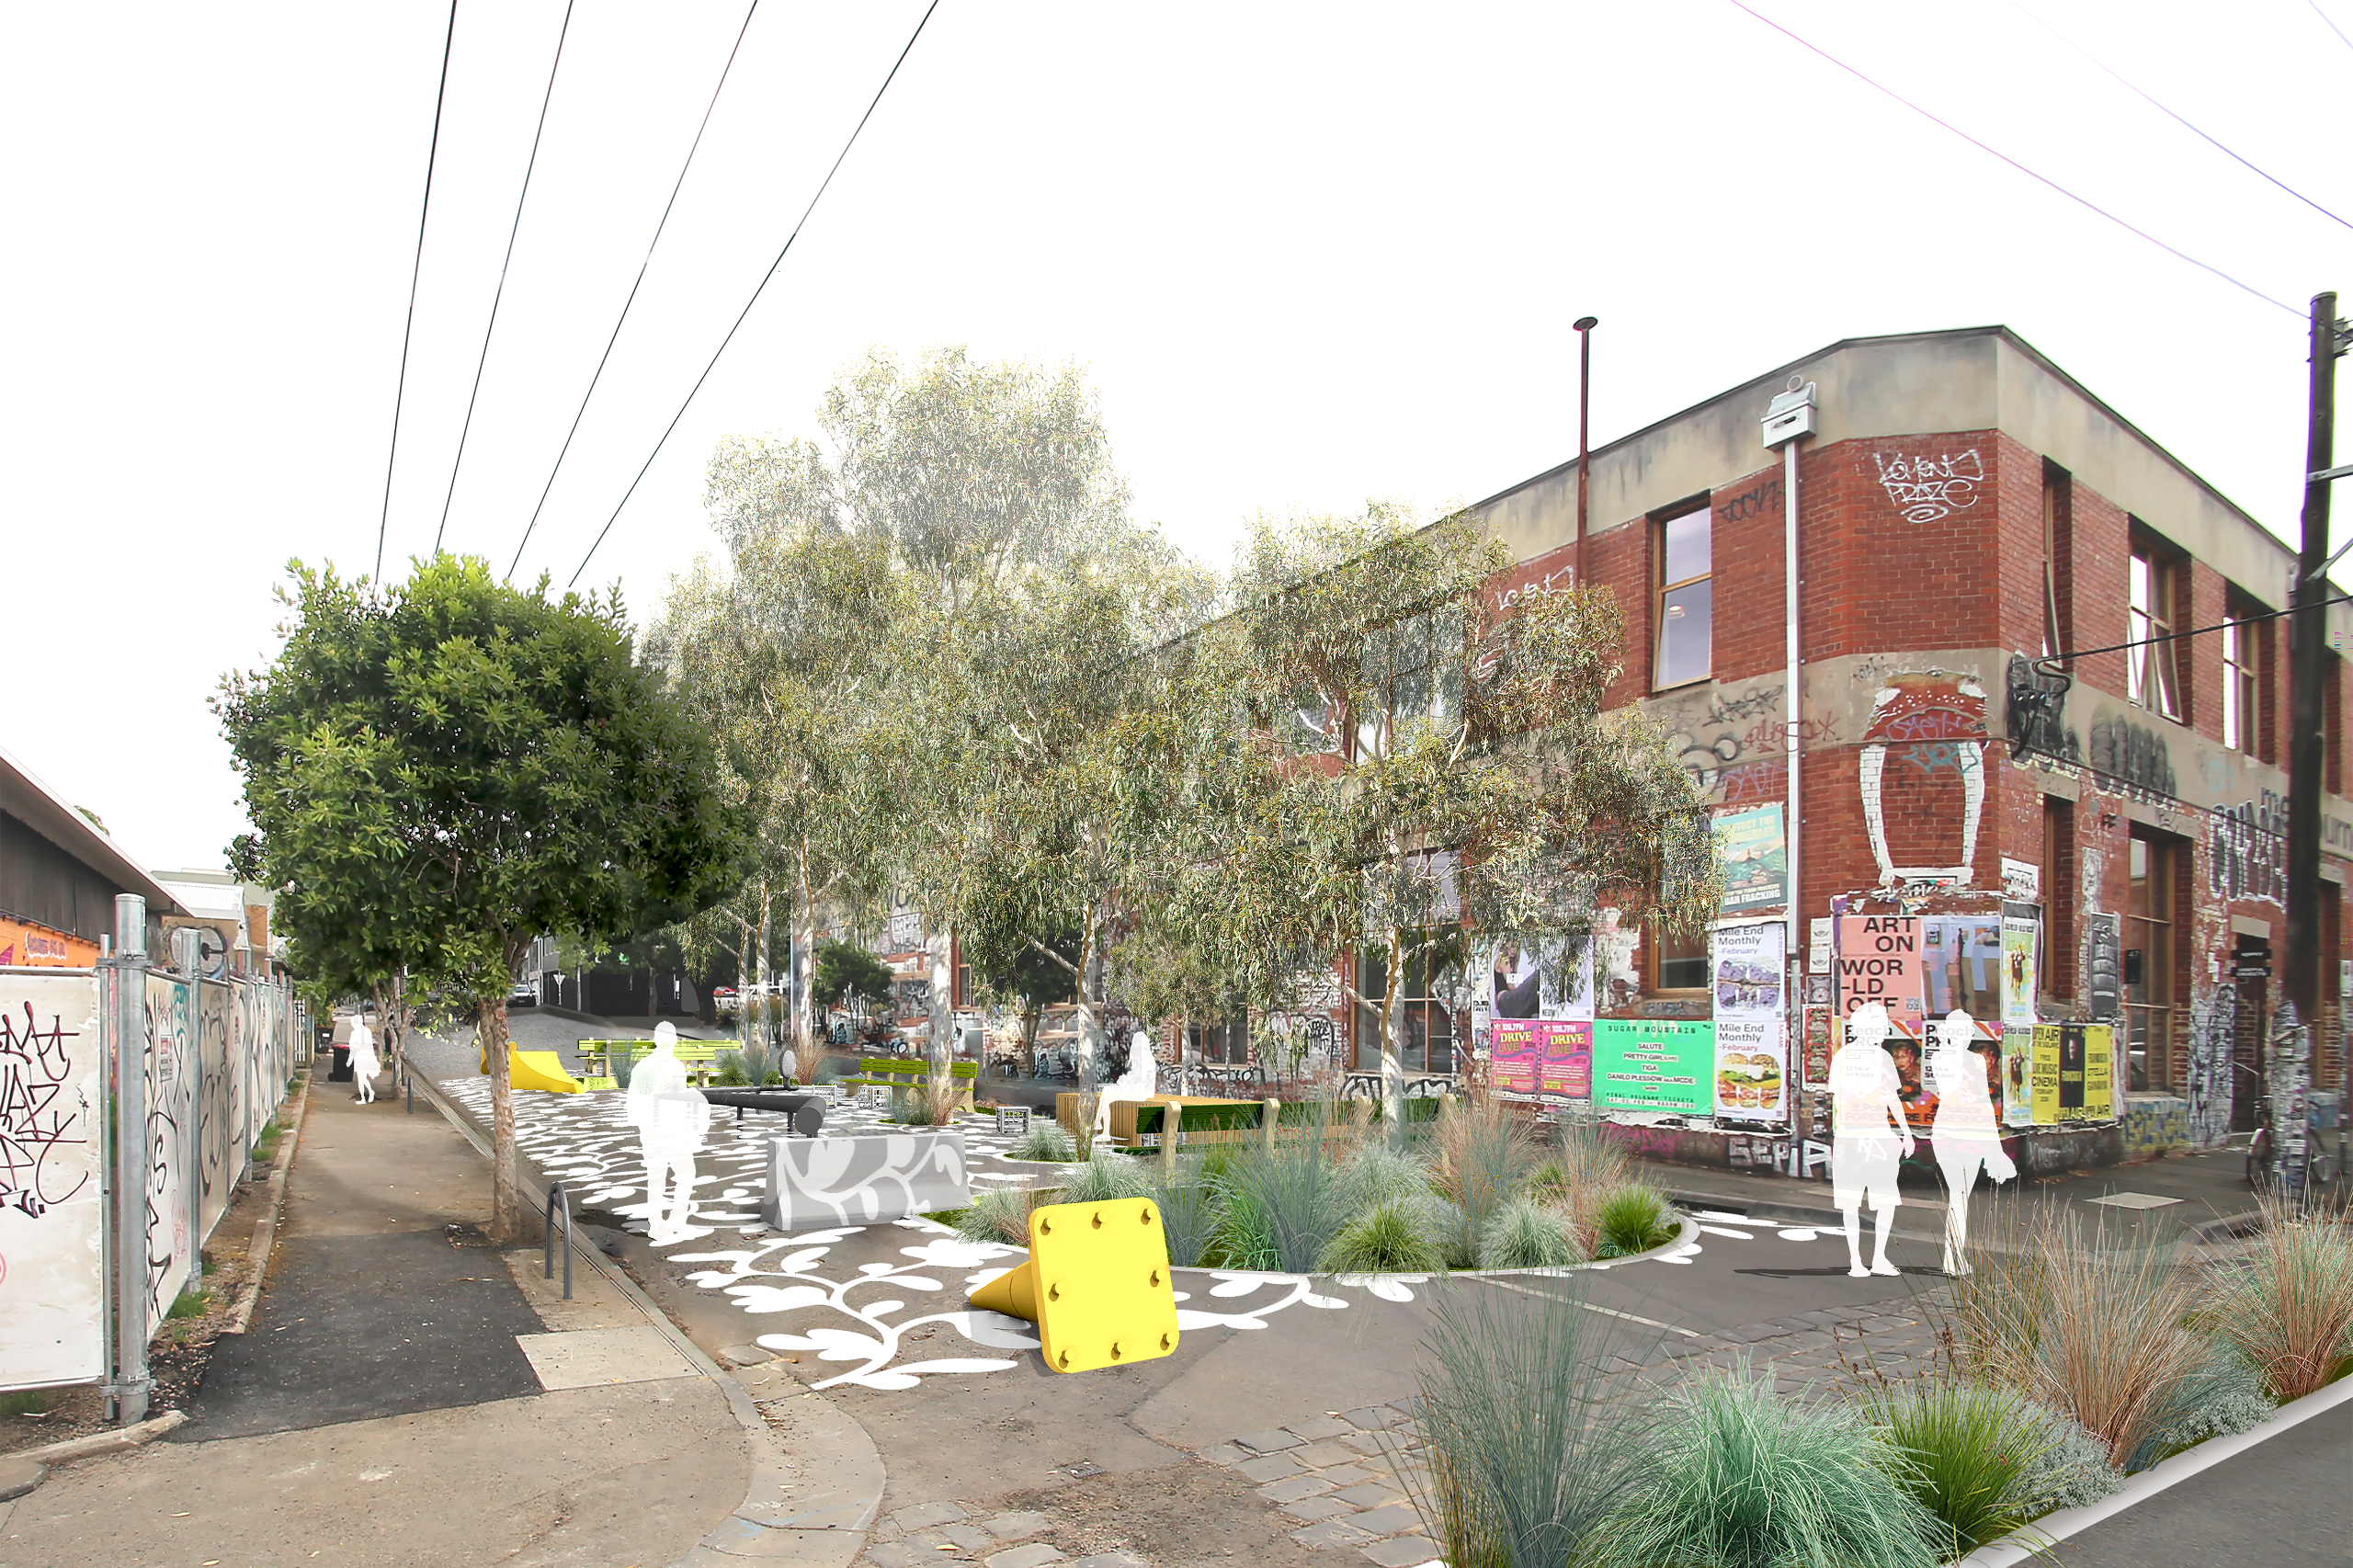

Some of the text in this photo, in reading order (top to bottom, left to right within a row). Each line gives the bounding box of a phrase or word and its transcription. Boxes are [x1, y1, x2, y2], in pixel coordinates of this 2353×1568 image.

[1741, 889, 1780, 903] FRACKING
[1744, 926, 1764, 935] End
[1863, 916, 1916, 933] ART
[1718, 937, 1761, 946] Monthly
[1875, 936, 1913, 952] ON
[1840, 960, 1903, 975] WOR
[1841, 978, 1883, 994] -LD
[1644, 1026, 1696, 1034] MOUNTAIN
[1719, 1024, 1765, 1032] Mile End
[1500, 1031, 1532, 1043] DRIVE
[1550, 1033, 1585, 1045] DRIVE
[1719, 1033, 1761, 1043] Monthly
[2045, 1028, 2059, 1041] AIR
[1498, 1042, 1520, 1052] LIVE
[1549, 1044, 1573, 1055] LIVE
[2032, 1076, 2058, 1087] CINEMA
[2097, 1104, 2109, 1116] AIR
[1729, 1136, 1833, 1180] SEPIA
